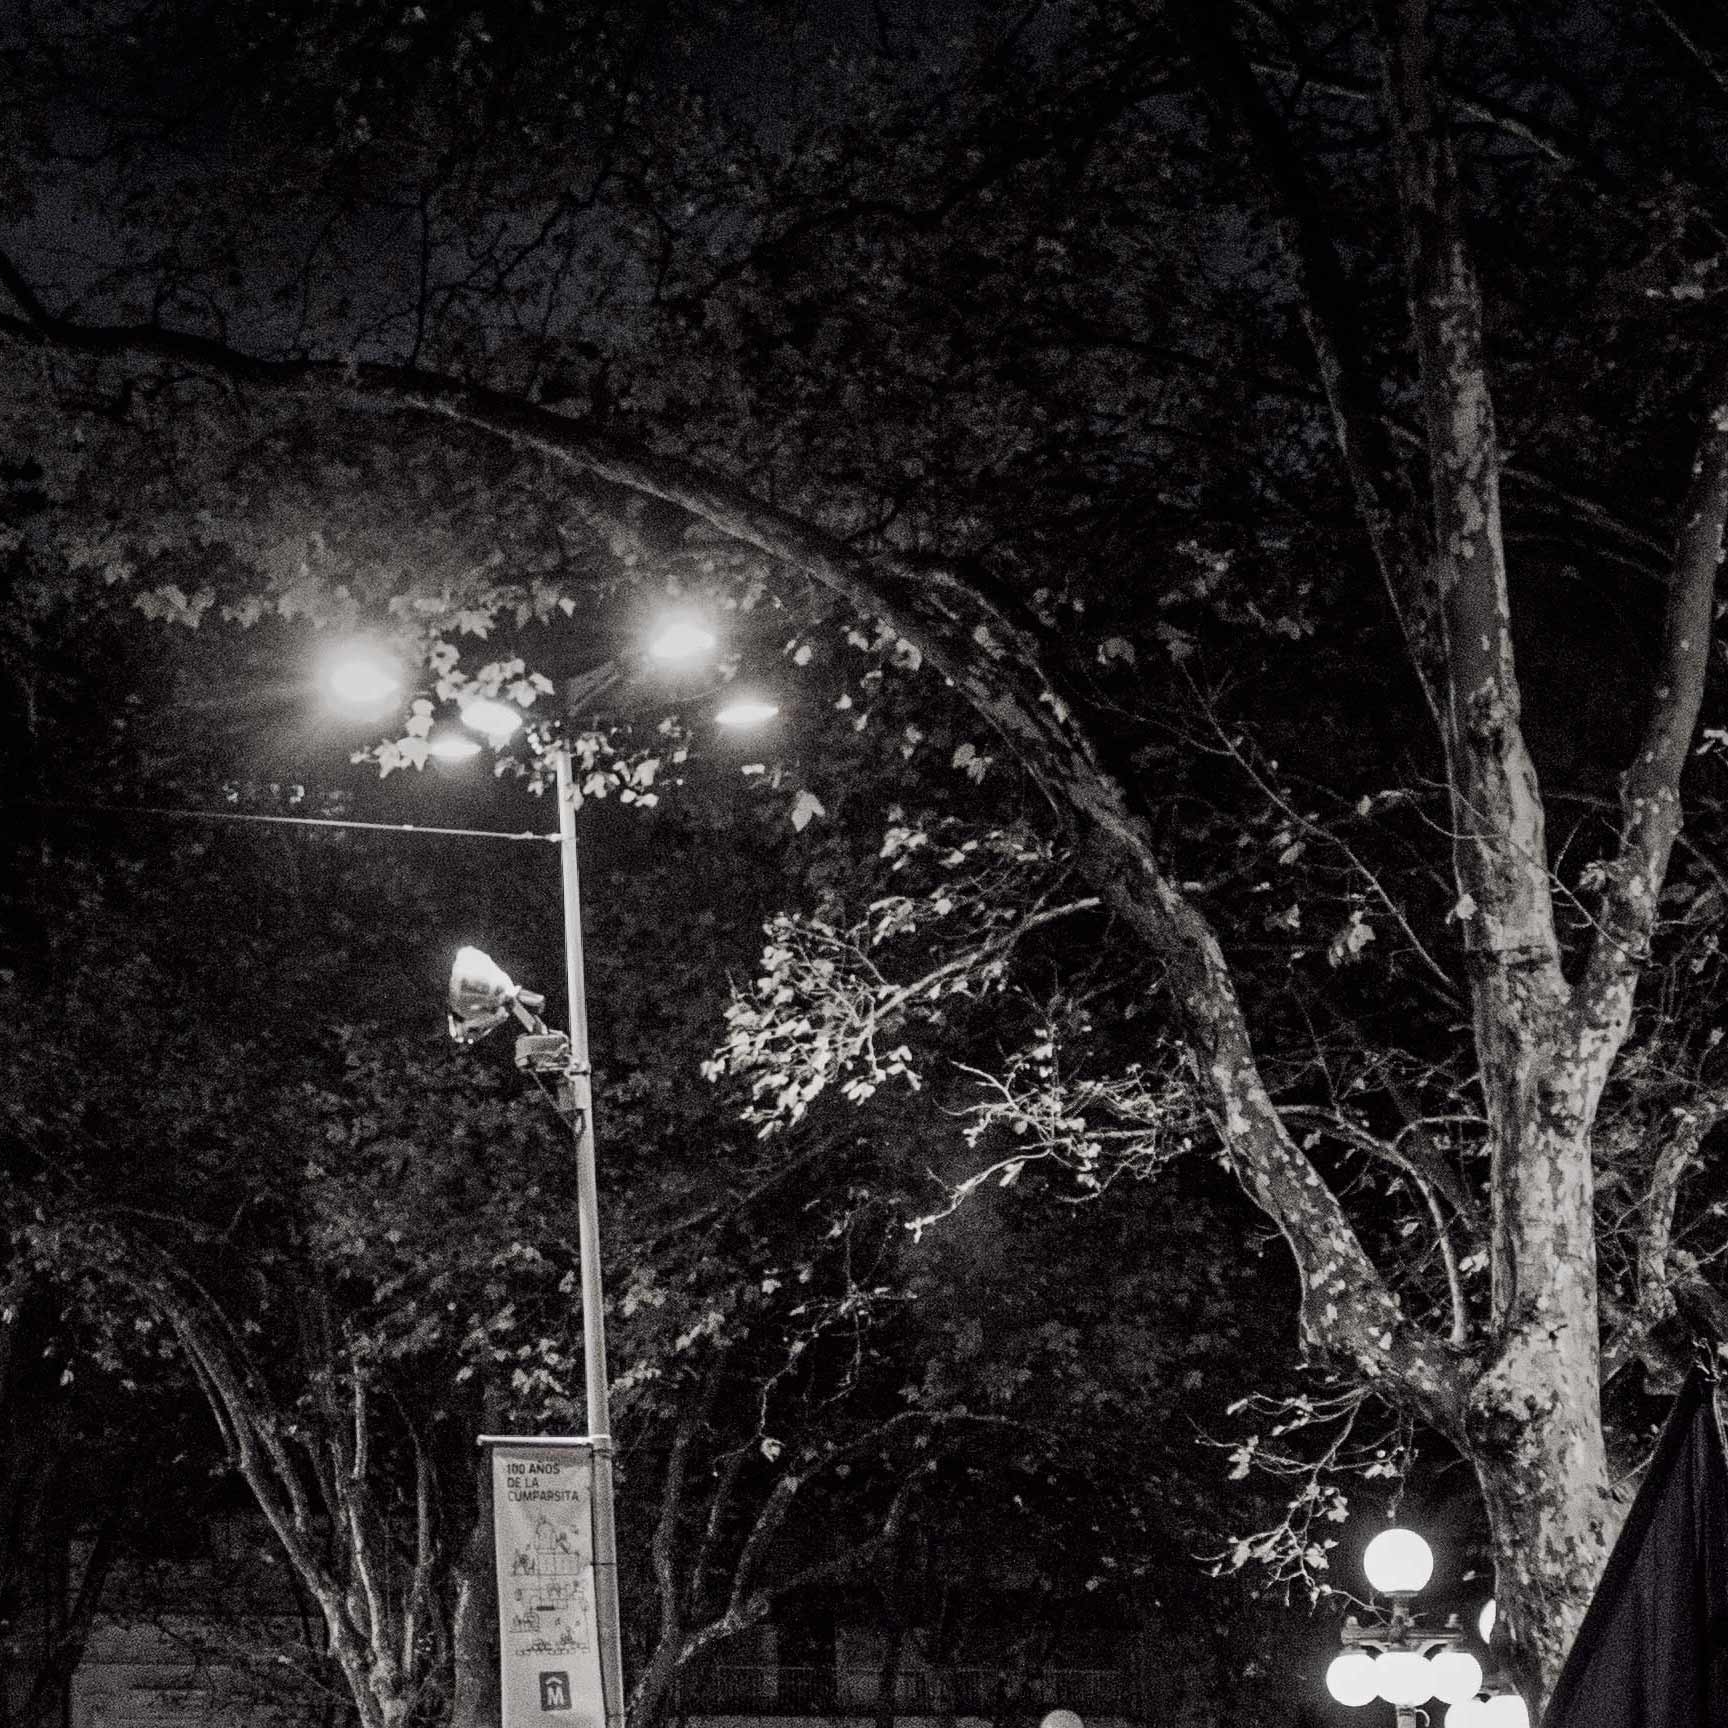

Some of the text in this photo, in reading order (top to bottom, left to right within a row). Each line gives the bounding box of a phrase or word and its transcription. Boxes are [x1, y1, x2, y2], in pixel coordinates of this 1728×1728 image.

[507, 1463, 526, 1475] 100
[507, 1476, 539, 1489] DE LA
[508, 1490, 579, 1502] CUMPARSITA
